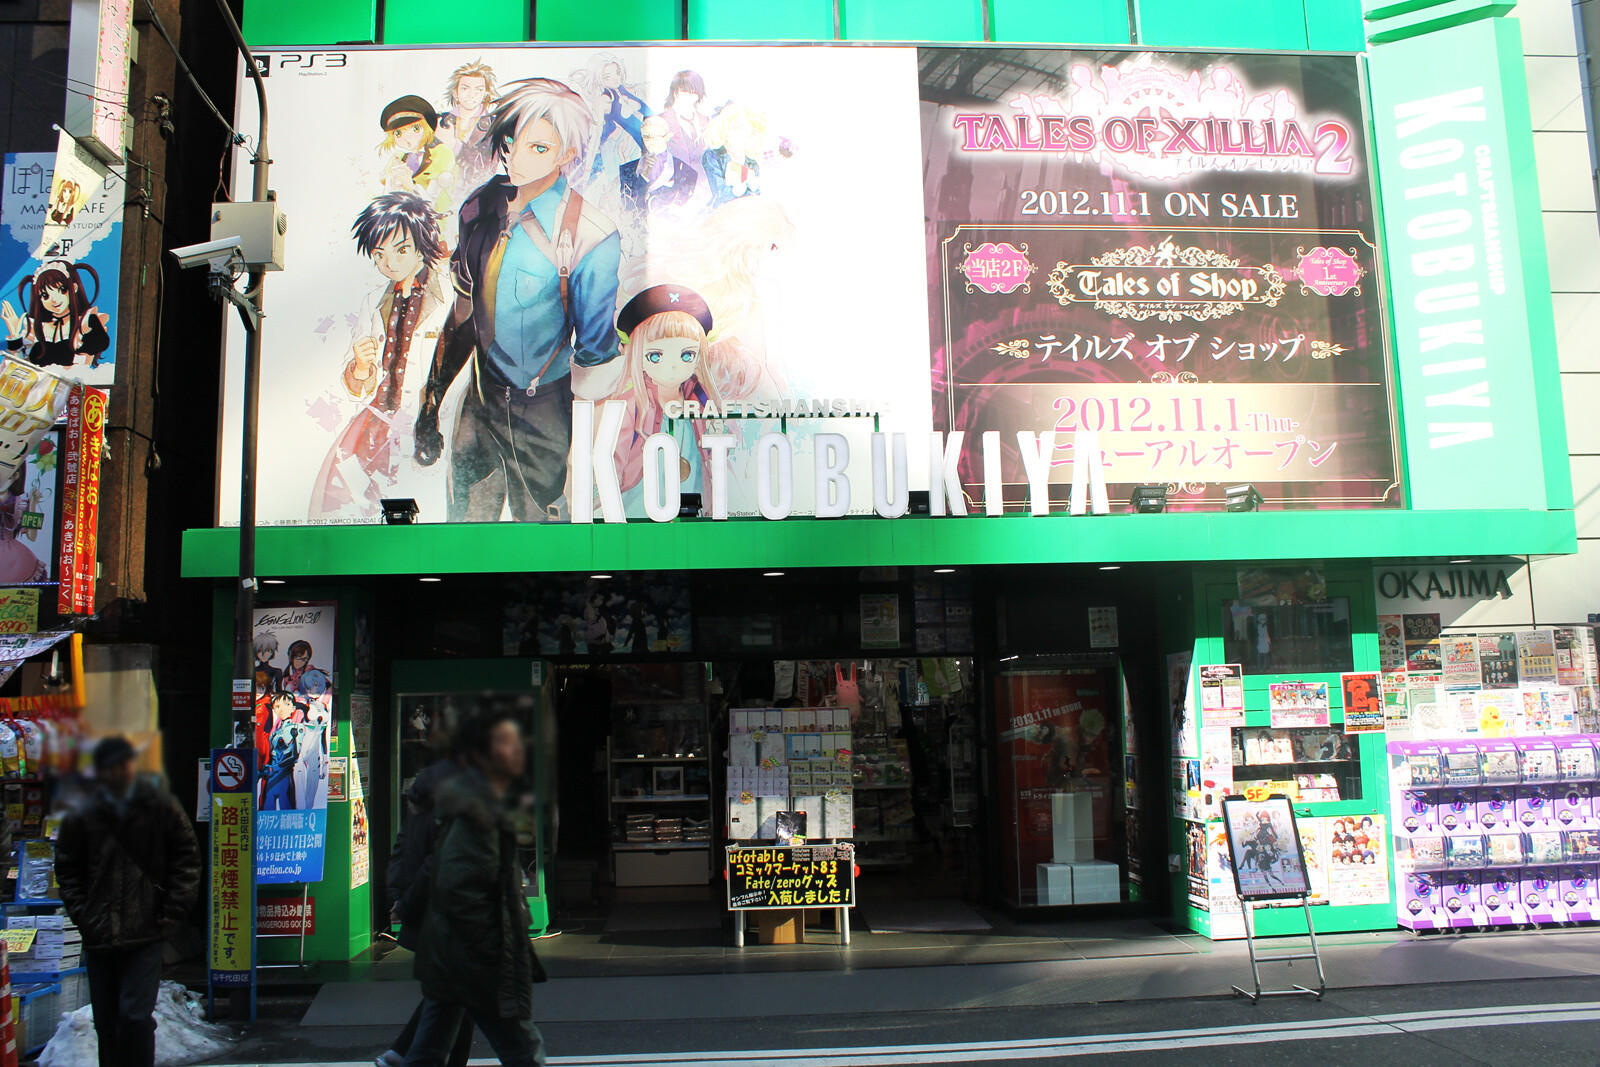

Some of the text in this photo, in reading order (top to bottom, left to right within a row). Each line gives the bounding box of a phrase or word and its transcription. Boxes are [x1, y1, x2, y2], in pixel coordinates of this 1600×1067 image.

[280, 54, 347, 68] PS3
[954, 113, 1356, 174] TALES OF XILLIA 2
[78, 202, 106, 214] AFE
[1020, 190, 1299, 220] 2012.11.1 ON SALE
[1474, 144, 1506, 295] CRAFTSMANSHIP
[970, 258, 1023, 279] 当店2F
[1323, 266, 1337, 280] 1st
[1393, 86, 1494, 449] KOTOBUKIYA
[1077, 270, 1258, 300] Tales of Shop
[1034, 333, 1306, 363] テイルズ オブ ショップ
[1052, 396, 1243, 435] 2012.11.1
[571, 399, 1111, 524] KOTOBUKIYA
[21, 514, 42, 528] OPEN
[1378, 568, 1514, 601] OKAJIMA
[1010, 701, 1083, 728] 2013.1.11 IN STORE
[1246, 788, 1264, 800] 5F
[240, 798, 250, 852] 千代田区内は
[730, 850, 785, 864] ufotable
[768, 888, 850, 906] 入荷しました！
